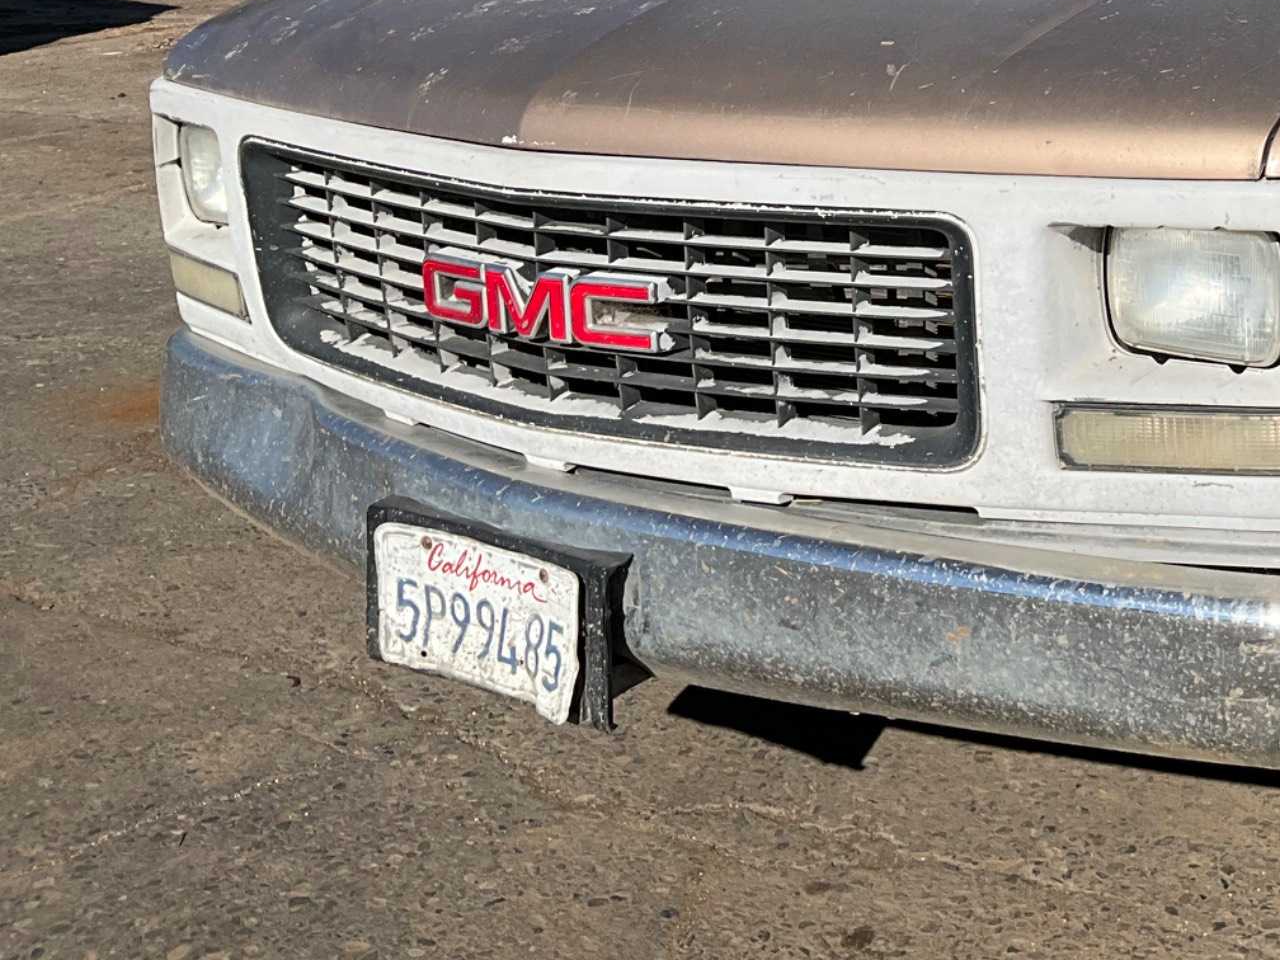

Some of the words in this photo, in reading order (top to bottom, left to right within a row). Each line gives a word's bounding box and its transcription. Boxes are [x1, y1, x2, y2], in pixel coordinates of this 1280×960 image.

[422, 257, 671, 354] GMC
[427, 542, 548, 603] California
[396, 579, 564, 692] 5P99485
